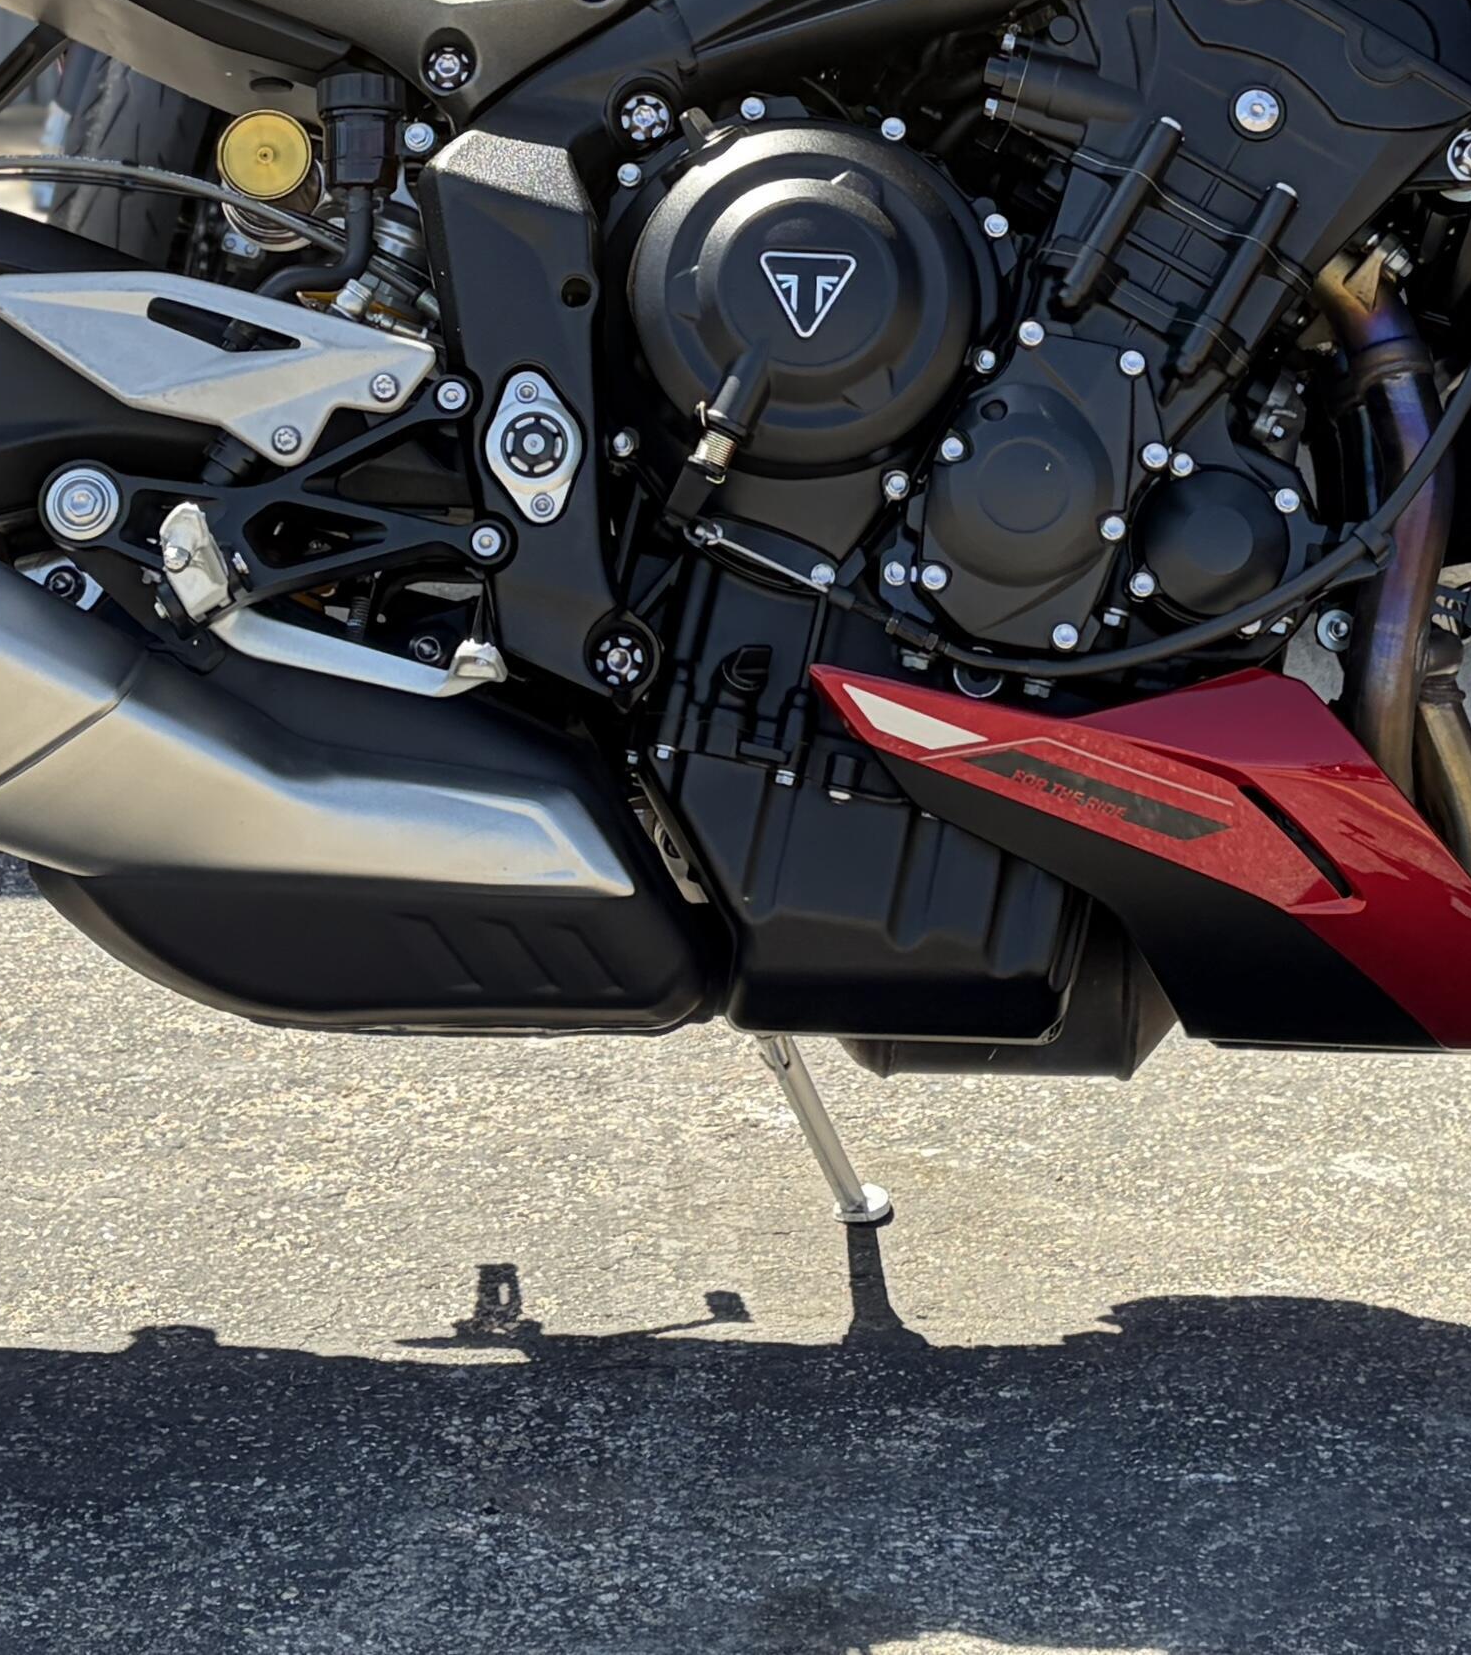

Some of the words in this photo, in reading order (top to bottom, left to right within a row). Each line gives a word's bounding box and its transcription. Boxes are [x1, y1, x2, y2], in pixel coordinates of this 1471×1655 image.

[1012, 769, 1049, 791] FOR
[1051, 782, 1085, 804] THE
[1085, 796, 1128, 818] RIDE
